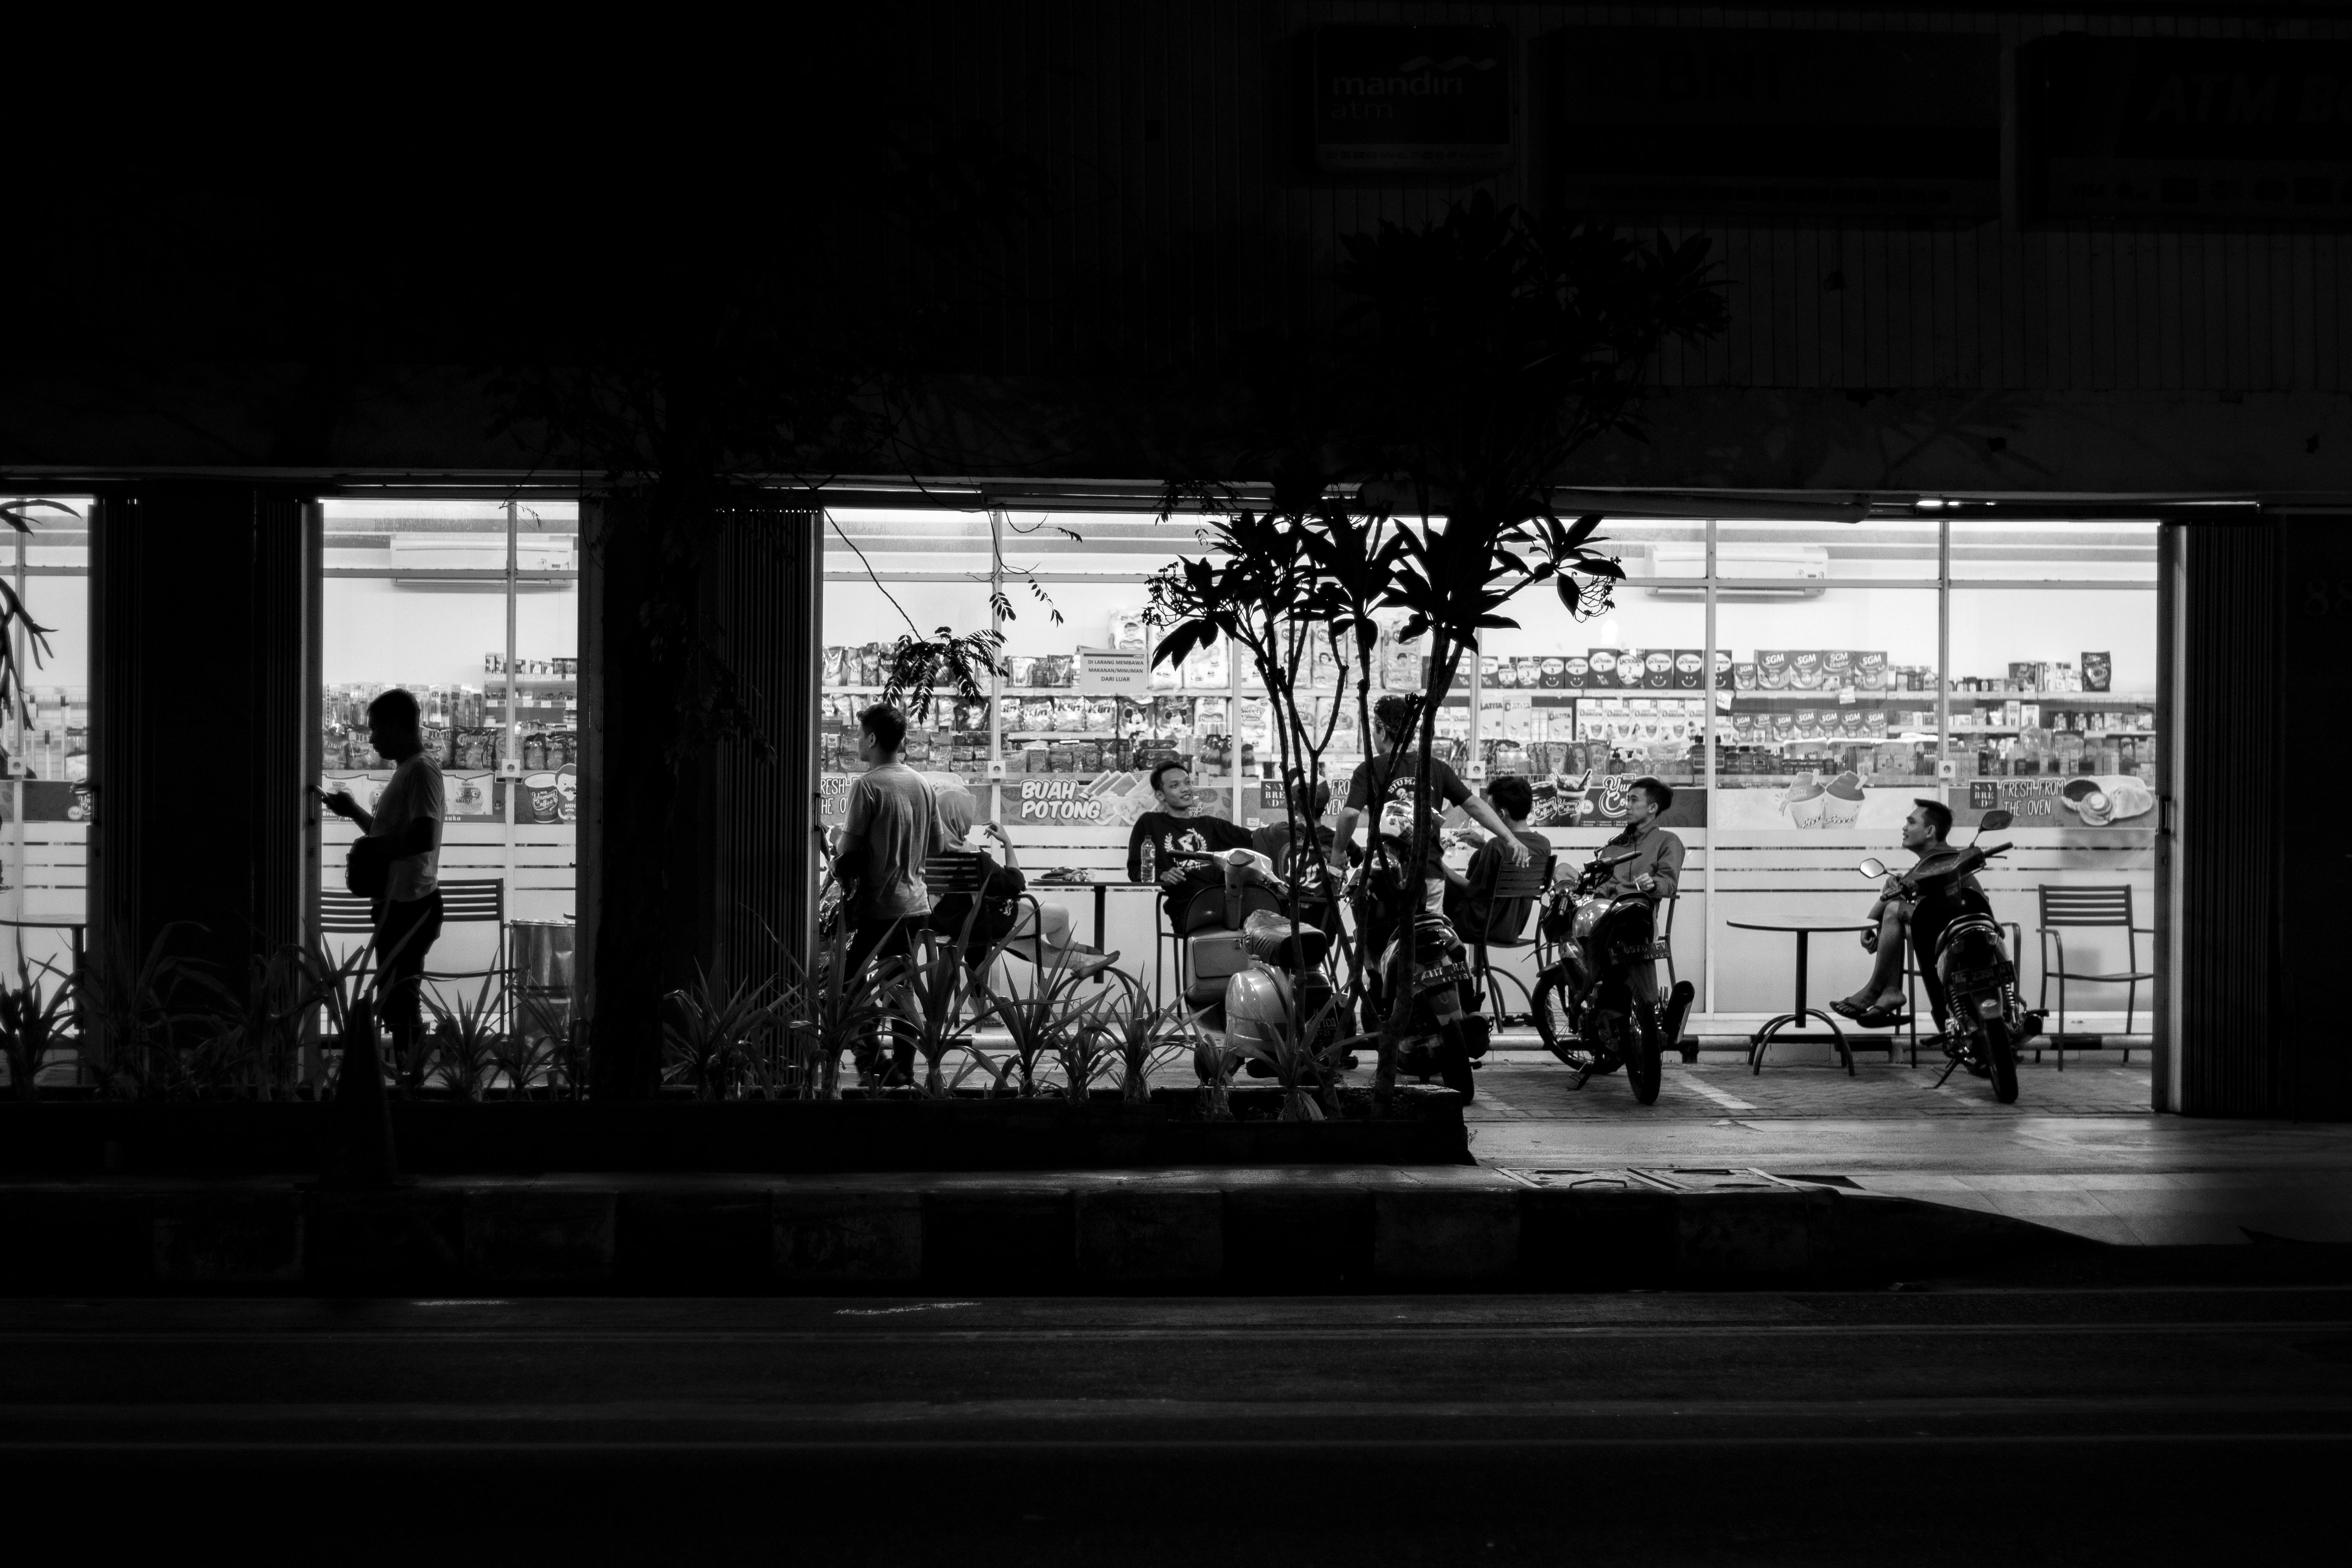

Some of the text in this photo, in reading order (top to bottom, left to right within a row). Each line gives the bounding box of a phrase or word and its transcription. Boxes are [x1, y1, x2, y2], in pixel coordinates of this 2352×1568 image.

[1332, 70, 1463, 95] mandiri
[1658, 51, 1778, 103] BNI
[2146, 72, 2280, 124] ATM
[1331, 100, 1393, 119] atm
[1765, 653, 1784, 665] SGM
[1797, 652, 1816, 665] SGM
[1830, 652, 1848, 661] SGM
[1862, 654, 1881, 665] SGM
[1740, 664, 1753, 672] SGM
[1241, 705, 1265, 717] Sweety
[1798, 712, 1814, 722] SGM
[1822, 712, 1837, 722] SGM
[1845, 712, 1860, 722] SGM
[1868, 712, 1884, 722] SGM
[1737, 716, 1750, 724] SGM
[1778, 716, 1791, 725] SGM
[821, 778, 846, 795] RESH
[1021, 781, 1077, 800] BUAH
[1331, 779, 1350, 795] FRO
[2002, 780, 2064, 798] FRESH FROM
[821, 797, 834, 814] HE
[1323, 799, 1345, 815] VEN
[1533, 799, 1555, 809] Yummy
[1558, 798, 1578, 807] Yummy
[2004, 799, 2051, 816] THE OVEN
[1021, 800, 1101, 819] POTONG
